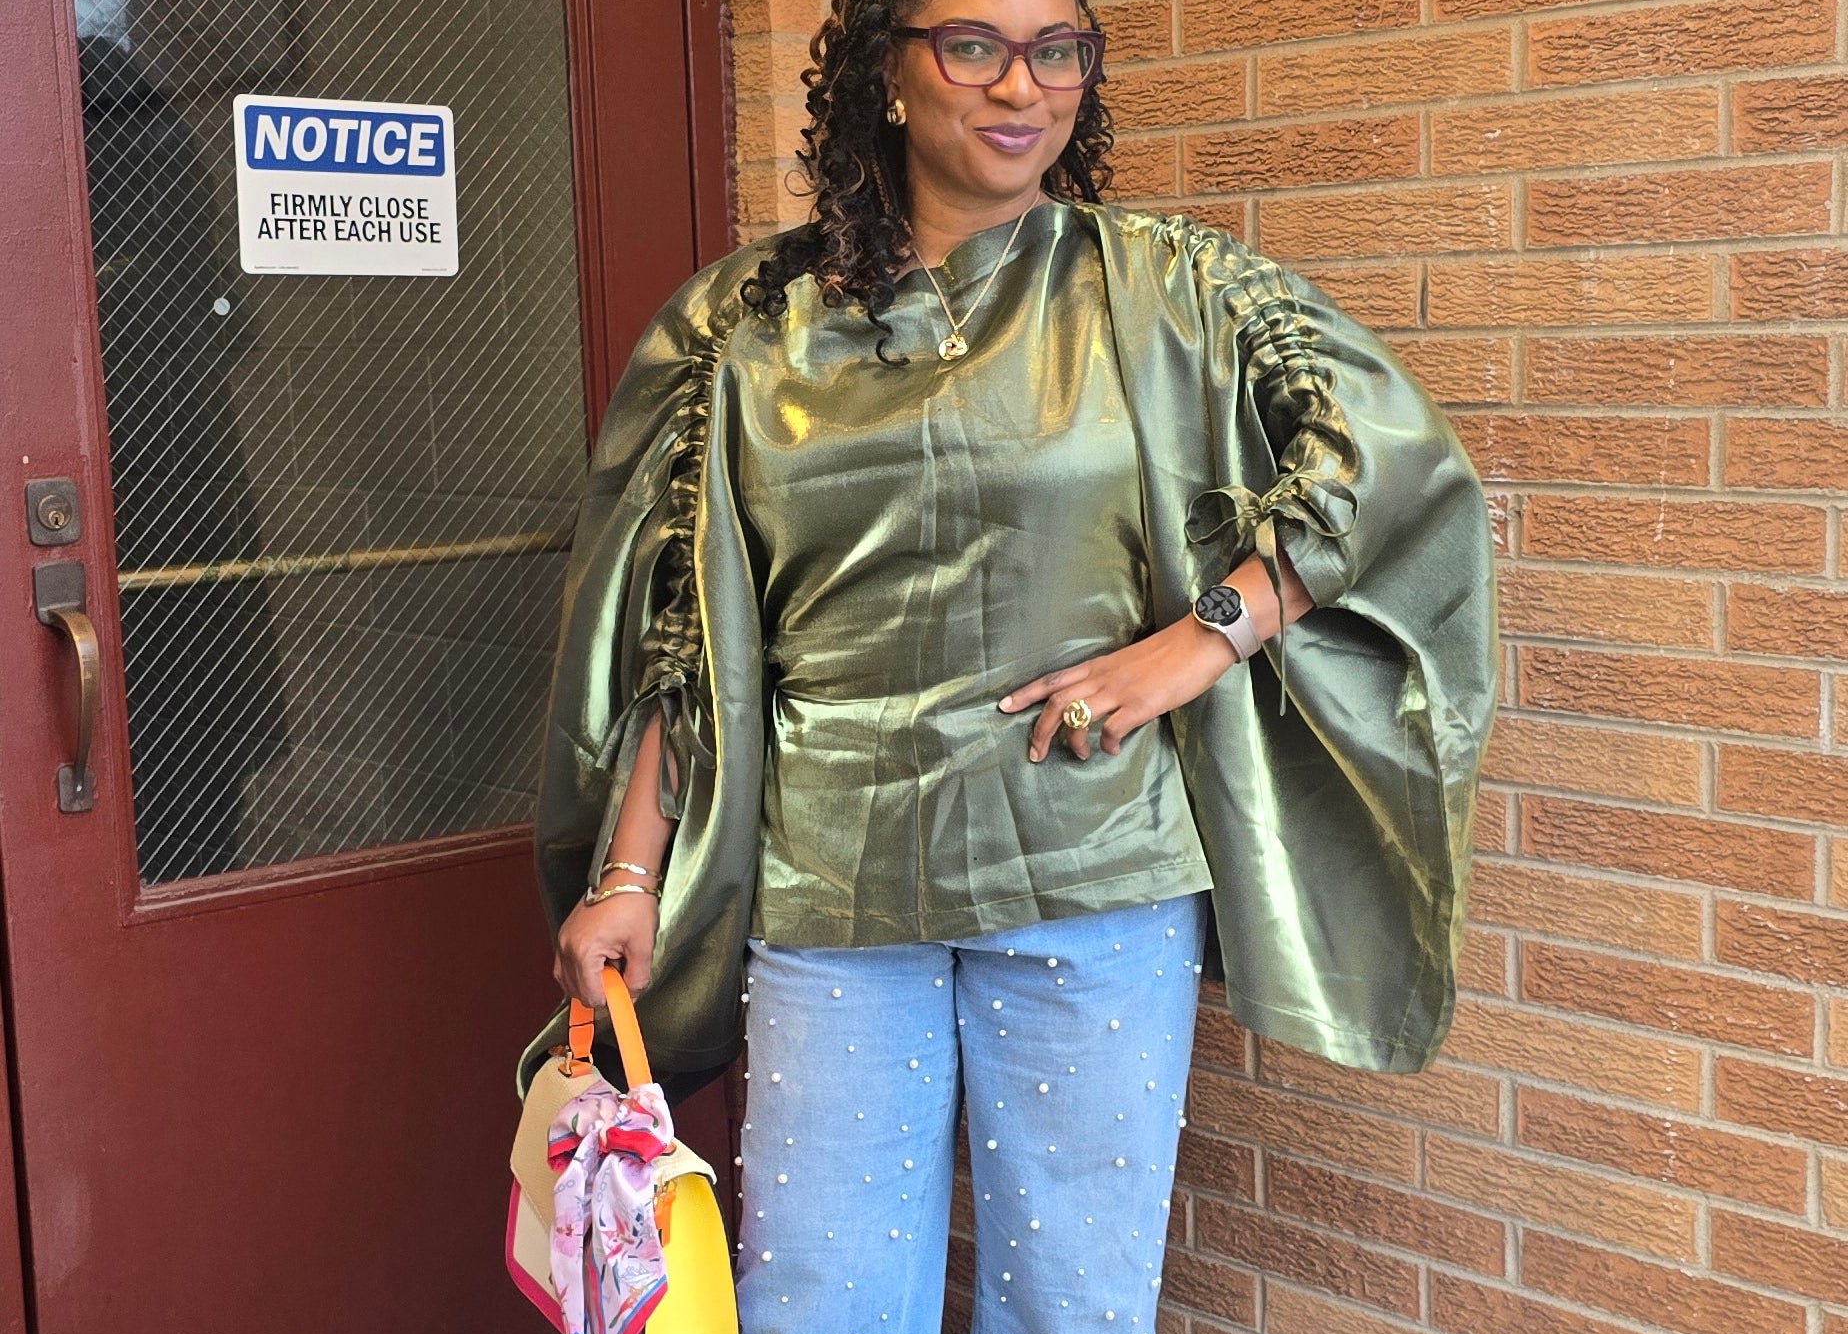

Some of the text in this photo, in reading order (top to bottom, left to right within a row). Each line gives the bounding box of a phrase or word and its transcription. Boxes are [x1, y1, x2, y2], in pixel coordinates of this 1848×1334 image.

[254, 114, 439, 166] NOTICE
[270, 193, 429, 219] FIRMLY CLOSE
[258, 217, 442, 243] AFTER EACH USE
